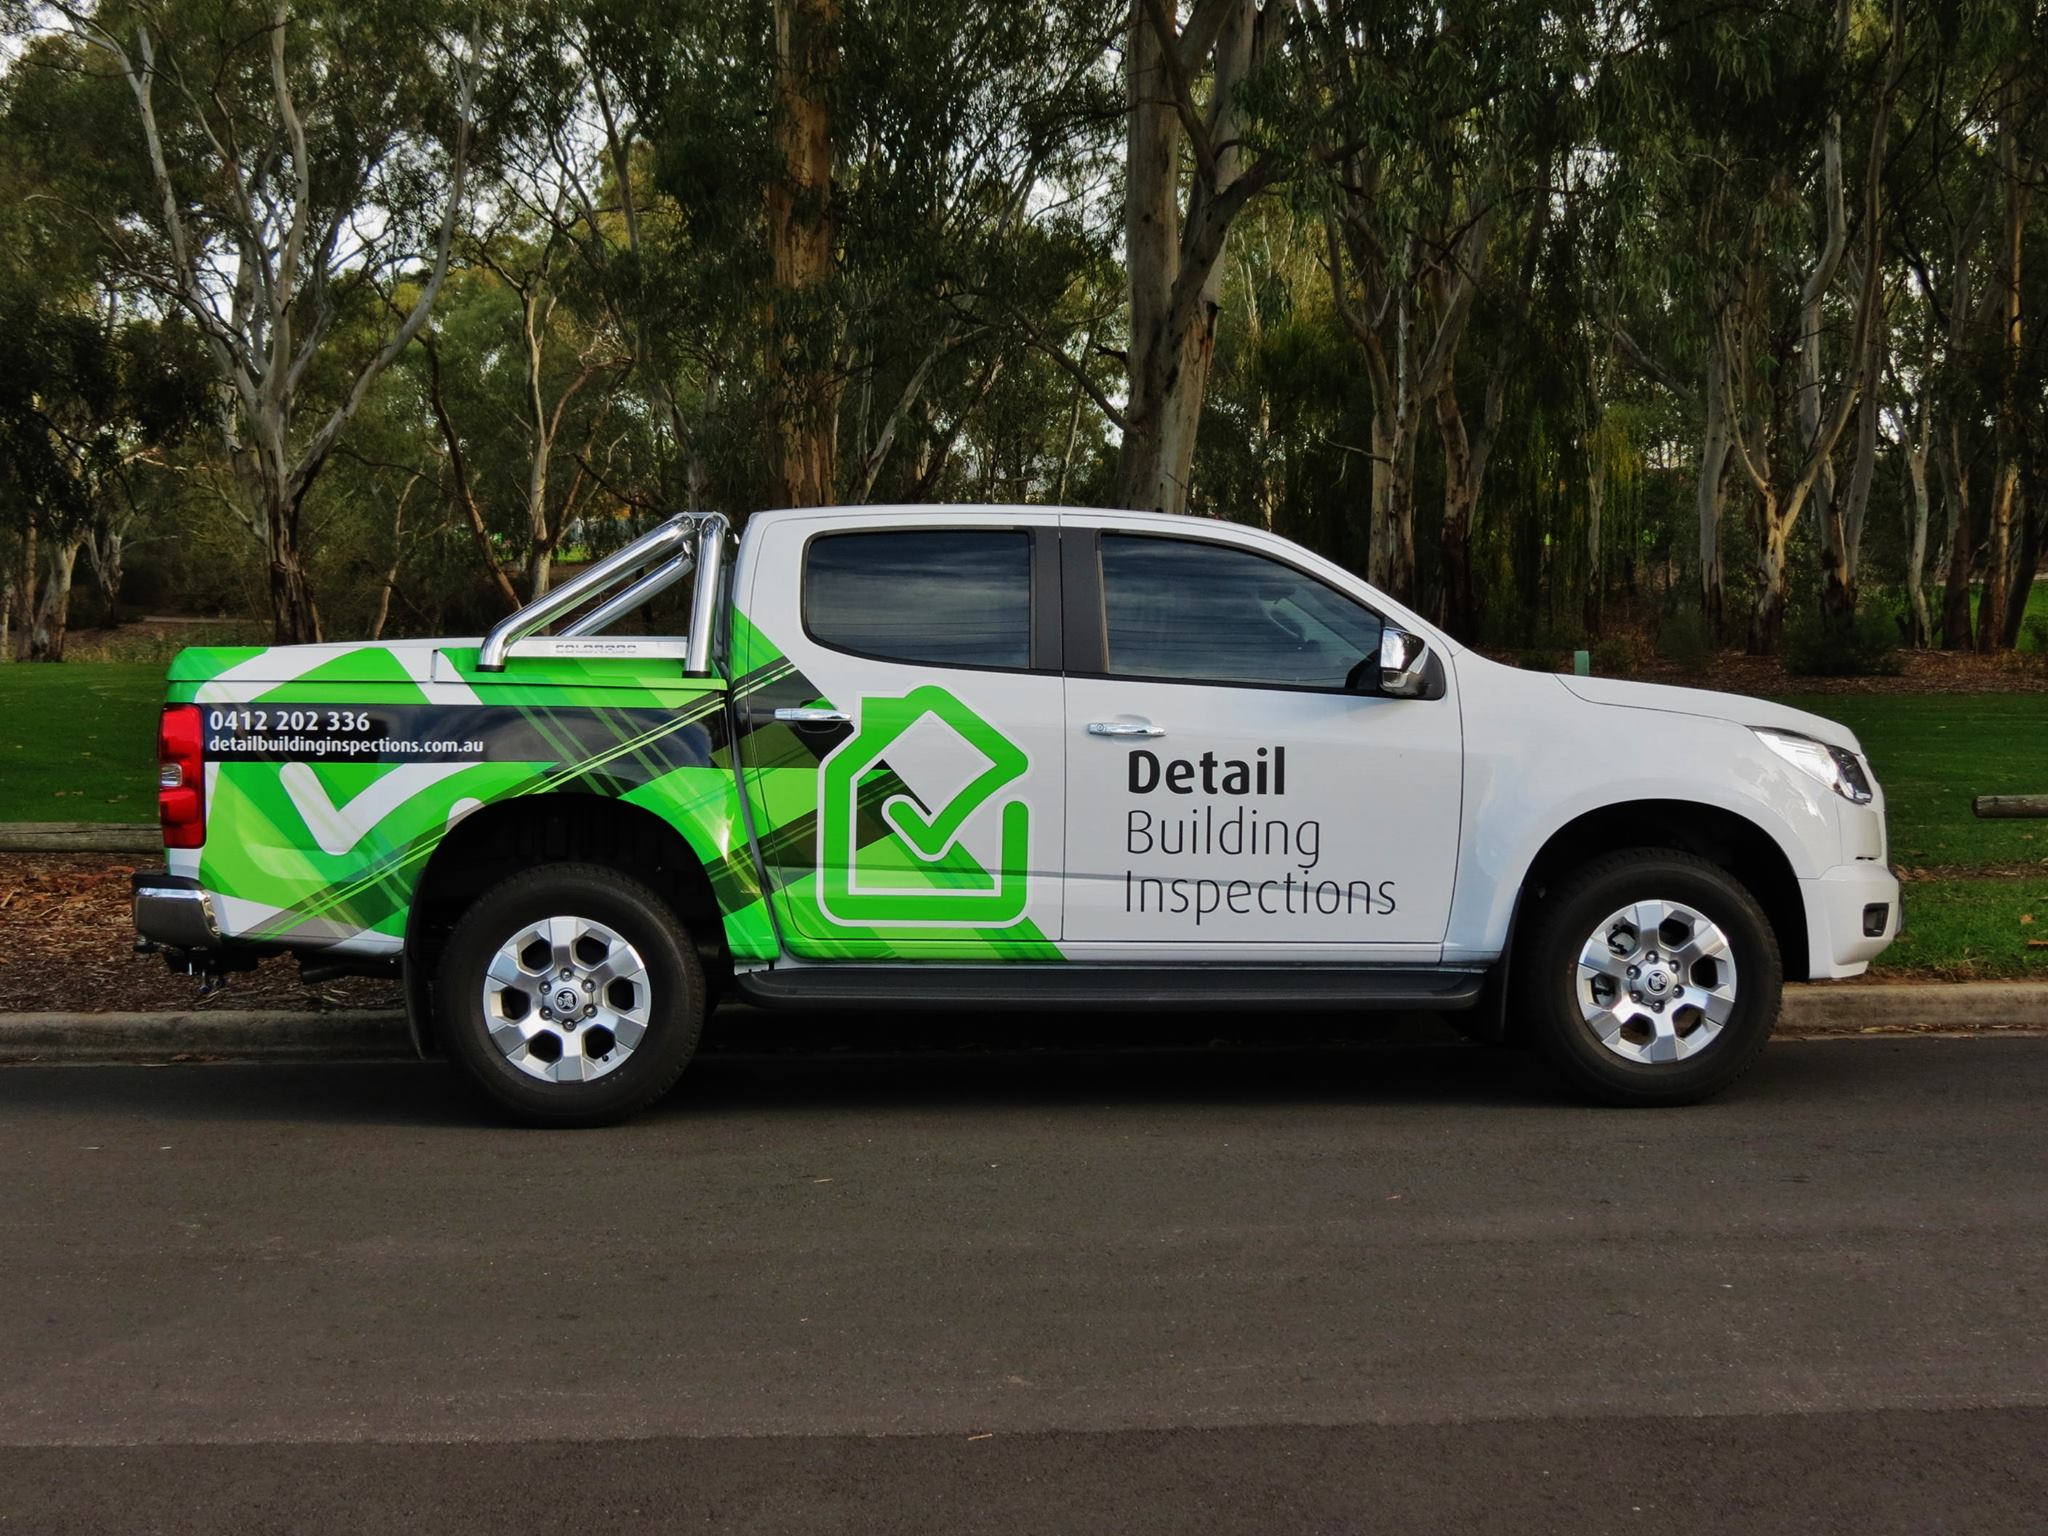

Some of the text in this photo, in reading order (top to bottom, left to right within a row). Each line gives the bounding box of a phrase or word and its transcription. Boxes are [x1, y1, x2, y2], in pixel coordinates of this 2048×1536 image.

[209, 711, 369, 731] 0412 202 336
[209, 735, 484, 756] detailbuildinginspections.com.au
[1128, 746, 1285, 795] Detail
[1127, 805, 1320, 868] Building
[1126, 870, 1396, 925] Inspections
